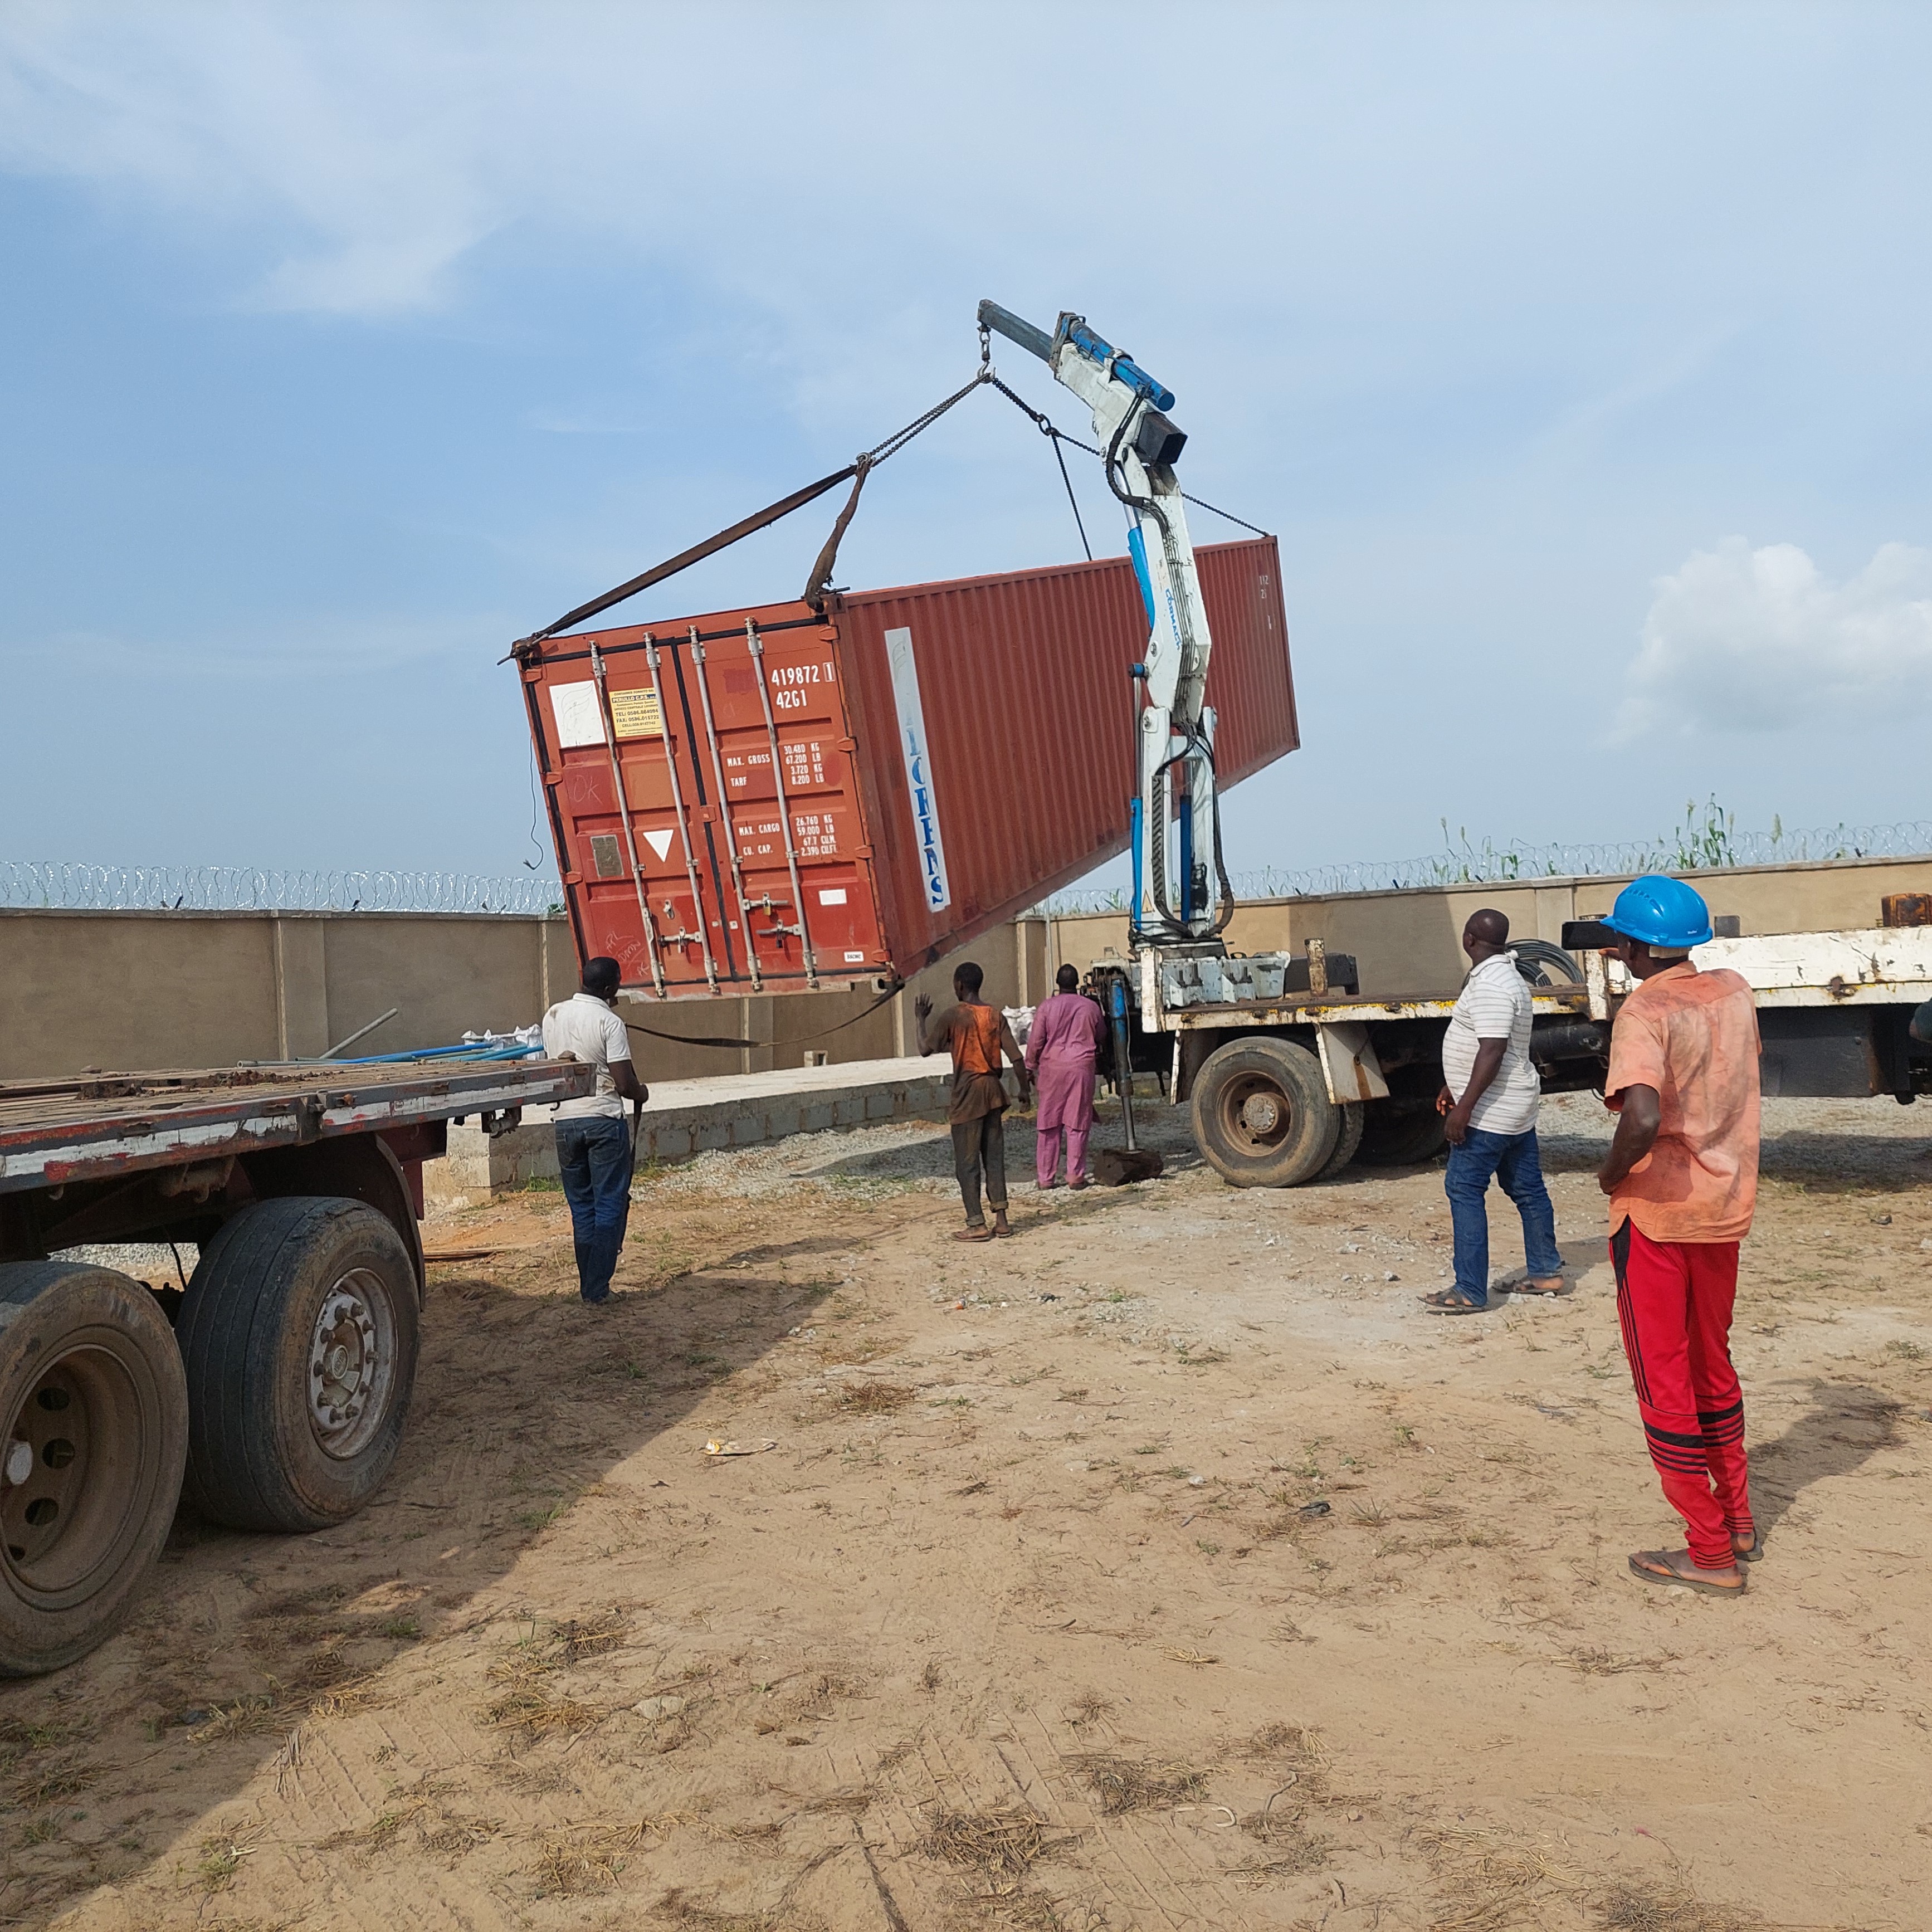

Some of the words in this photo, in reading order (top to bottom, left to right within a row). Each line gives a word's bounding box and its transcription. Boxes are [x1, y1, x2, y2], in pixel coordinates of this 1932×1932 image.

[771, 665, 821, 686] 419872
[824, 662, 834, 681] 1
[775, 689, 807, 709] 42G1
[783, 744, 806, 755] 30.480
[810, 742, 820, 752] KG
[726, 757, 745, 767] MAX.
[748, 754, 770, 765] GROSS
[785, 754, 807, 765] 67.200
[812, 753, 821, 763] LB
[791, 765, 809, 775] 3.720
[813, 763, 823, 773] KG
[791, 775, 810, 786] 8.200
[815, 773, 824, 783] LB
[796, 815, 819, 826] 26.760
[823, 814, 833, 824] KG
[739, 826, 757, 836] MAX.
[758, 823, 780, 833] CARGO
[797, 826, 821, 836] 59.000
[824, 823, 835, 835] LB
[803, 836, 818, 847] 67.7
[743, 846, 755, 856] CU.
[758, 843, 773, 855] CAP.
[801, 846, 819, 857] 2.390
